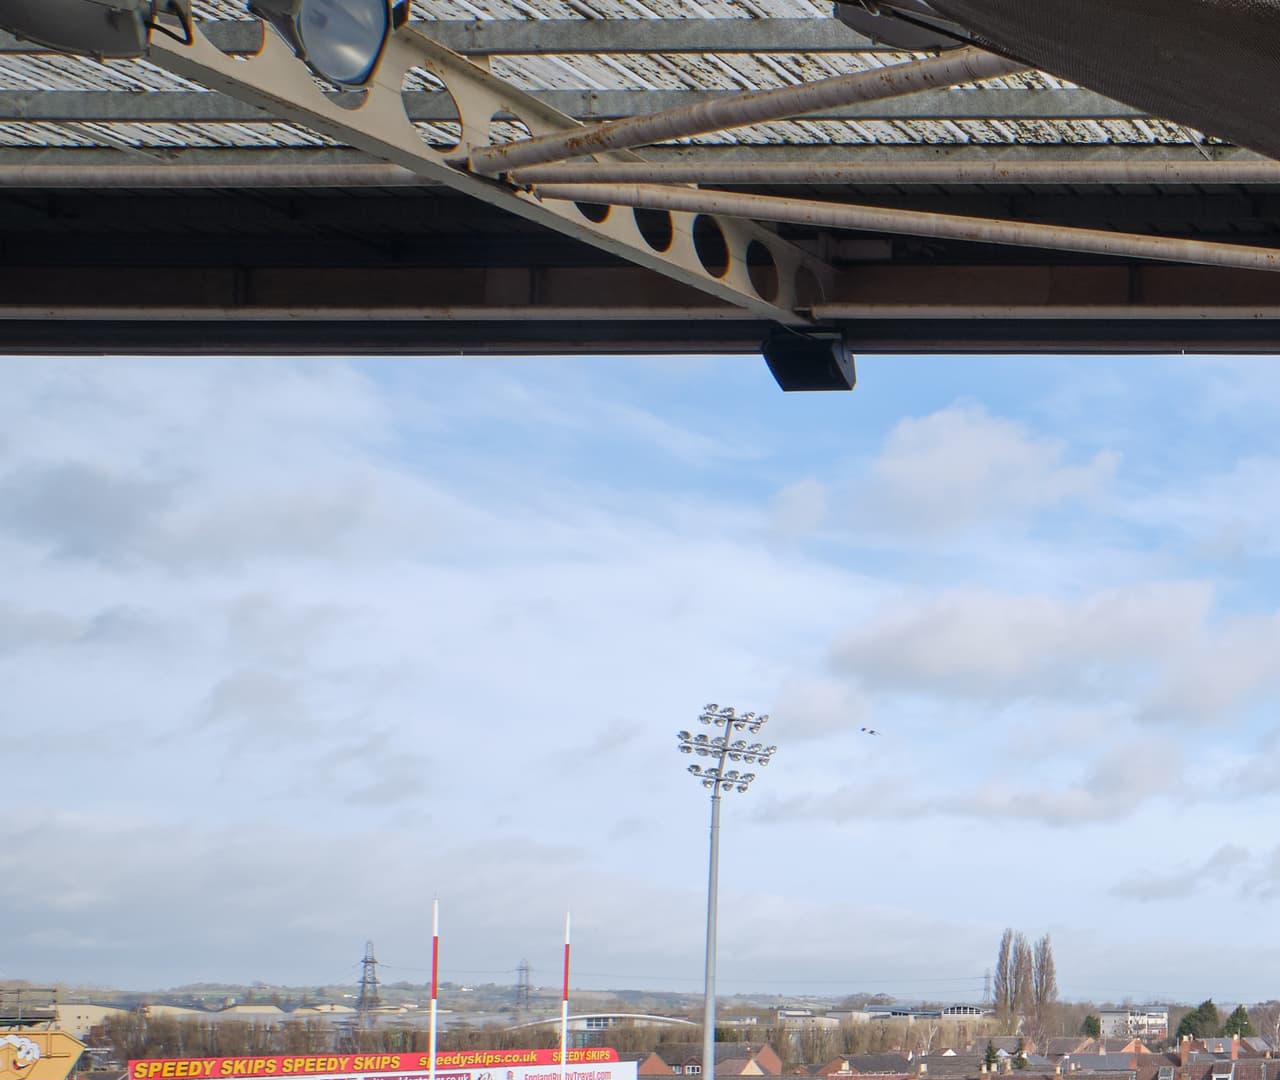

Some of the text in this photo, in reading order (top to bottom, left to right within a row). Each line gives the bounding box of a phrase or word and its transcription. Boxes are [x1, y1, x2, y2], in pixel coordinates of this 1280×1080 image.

[586, 1050, 610, 1061] SKIPS
[134, 1056, 400, 1079] SPEEDY SKIPS SPEEDY SKIPS
